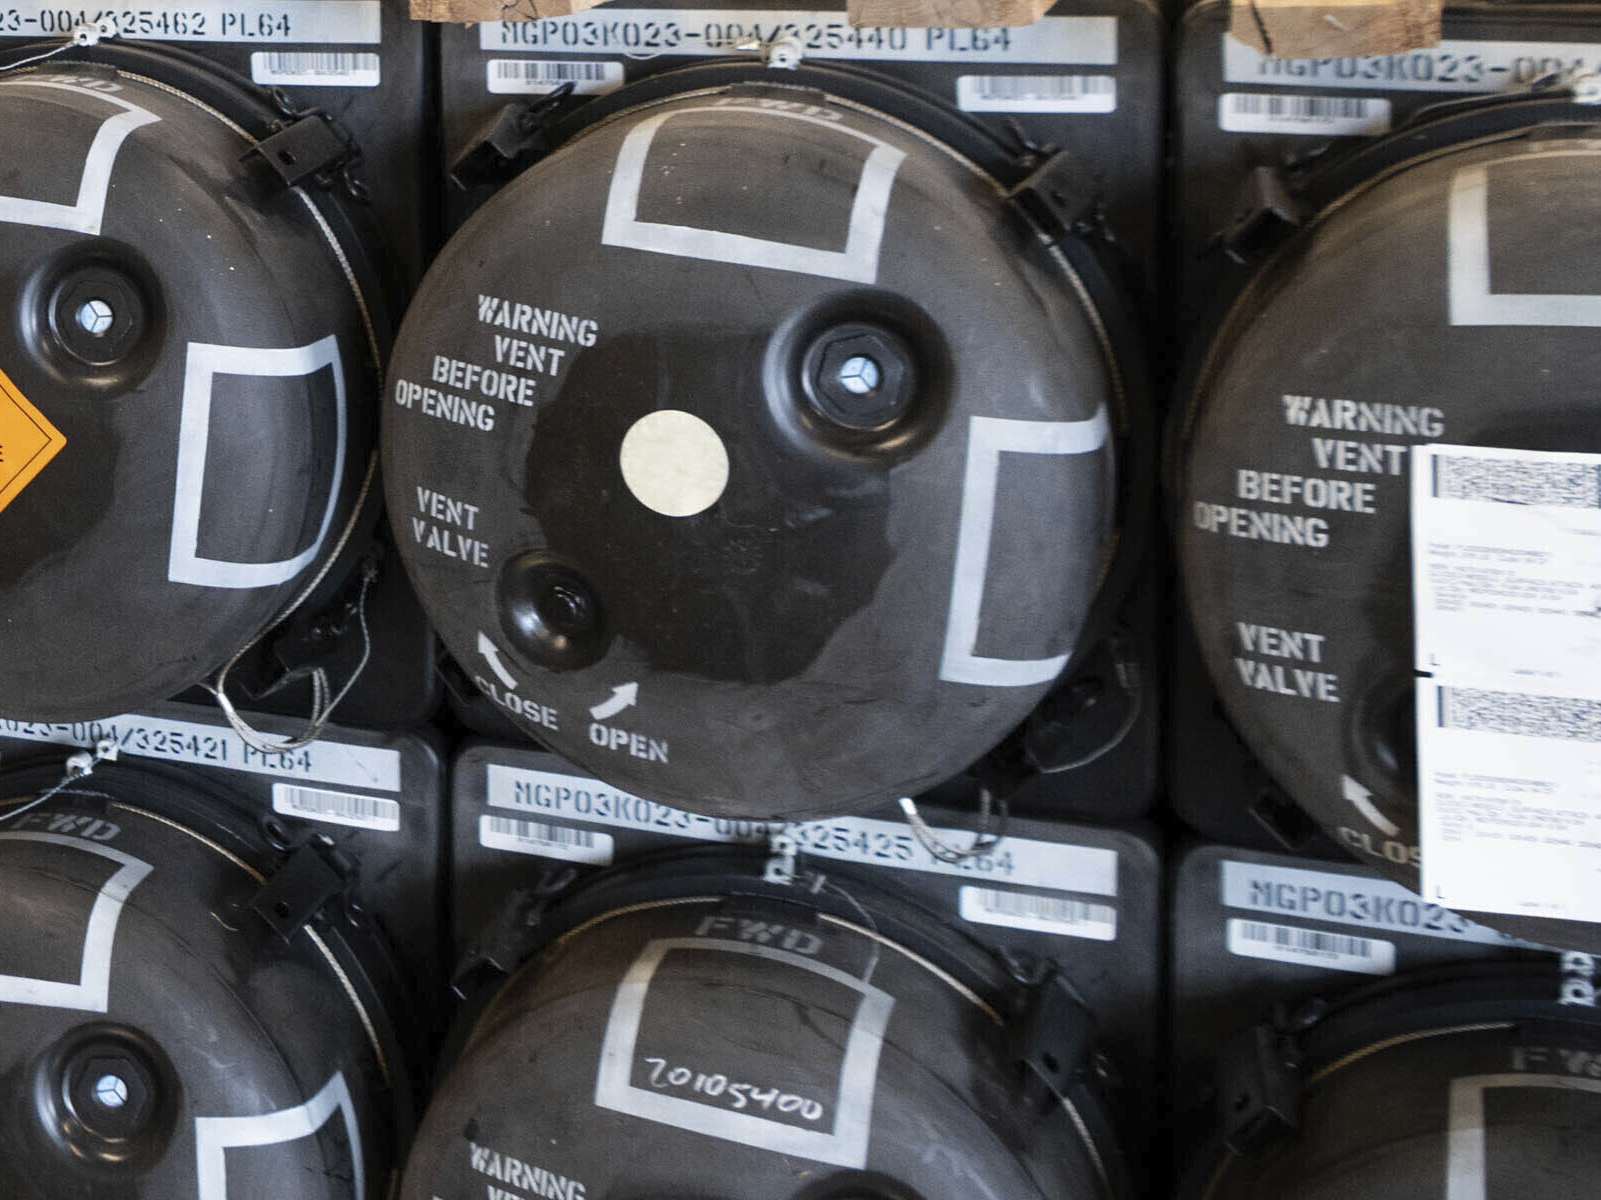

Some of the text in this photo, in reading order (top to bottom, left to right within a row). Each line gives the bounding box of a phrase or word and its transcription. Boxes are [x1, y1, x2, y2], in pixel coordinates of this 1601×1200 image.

[221, 12, 292, 37] PL64
[926, 27, 1011, 51] PL64
[478, 294, 598, 348] WARNING
[494, 335, 565, 377] VENT
[432, 355, 536, 407] BEFORE
[395, 379, 495, 432] OPENING
[1283, 394, 1445, 438] WARNING
[1312, 438, 1408, 476] VENT
[416, 486, 479, 531] VENT
[1236, 469, 1376, 515] BEFORE
[412, 518, 489, 569] VALVE
[1195, 502, 1330, 548] OPENING
[1236, 622, 1326, 664] VENT
[1234, 658, 1341, 703] VALVE
[475, 675, 669, 764] CLOSE OPEN
[10, 810, 121, 844] FWD
[1339, 825, 1421, 869] CLOS
[696, 916, 824, 956] FWD
[469, 1142, 587, 1200] WARNING
